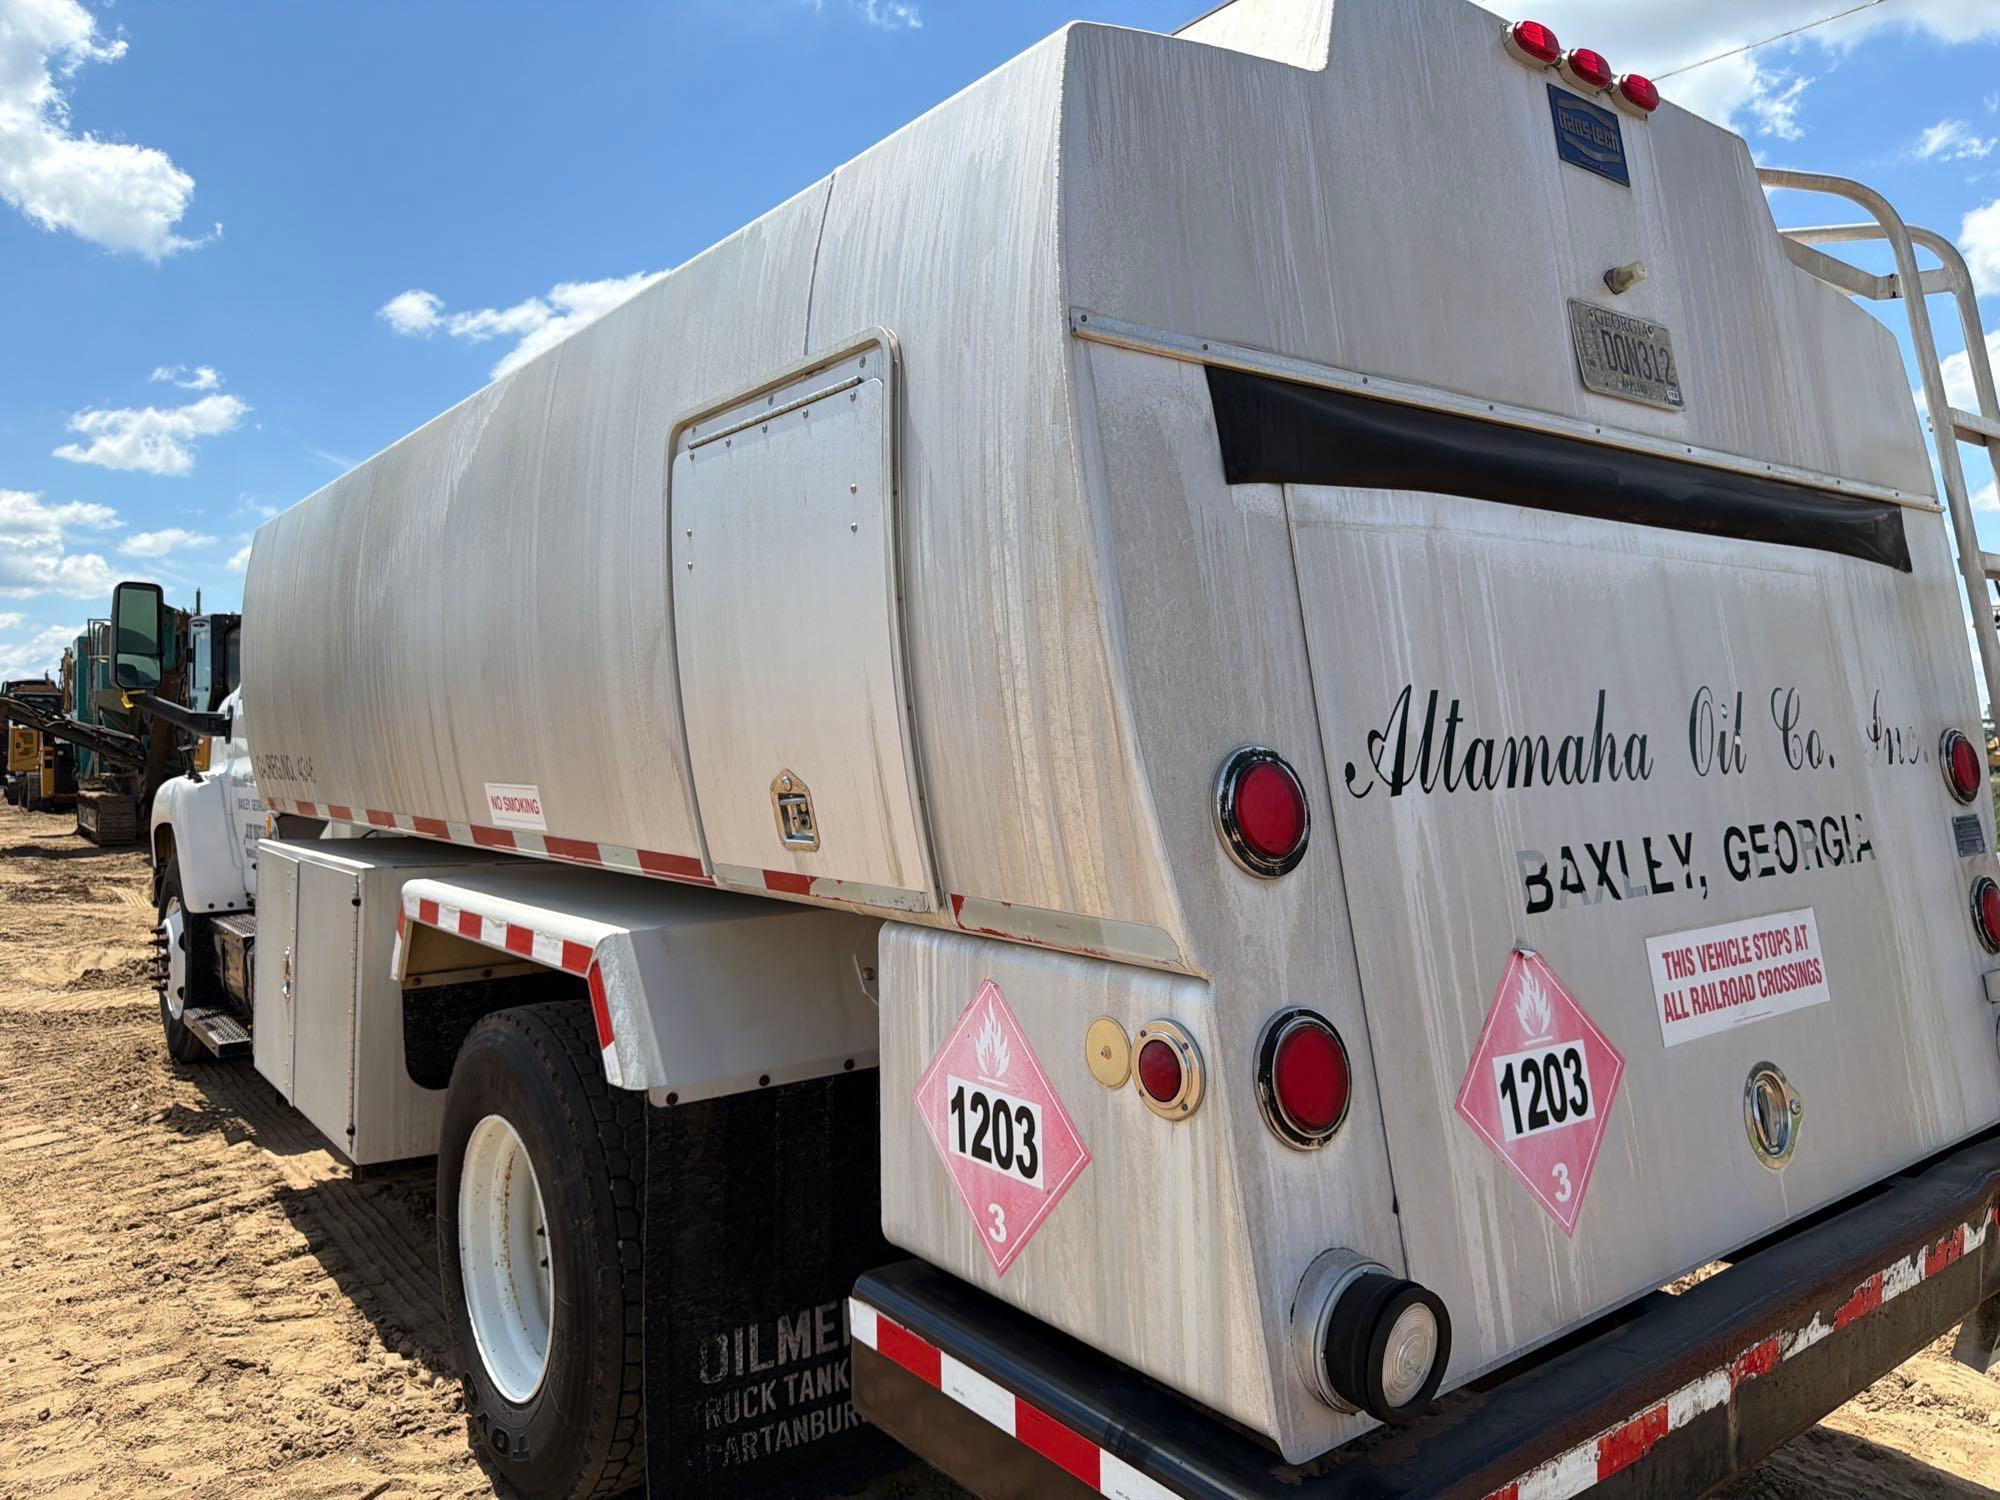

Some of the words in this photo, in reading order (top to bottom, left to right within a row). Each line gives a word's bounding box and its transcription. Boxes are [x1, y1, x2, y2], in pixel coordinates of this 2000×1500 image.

[1594, 308, 1650, 338] GEORGIA
[1345, 684, 1653, 798] Altamaha
[1689, 685, 1747, 776] Oil
[1770, 687, 1835, 770] Co.
[491, 795, 503, 811] NO
[503, 796, 540, 815] SMOKING
[1516, 831, 1708, 915] BAXLEY,
[1724, 813, 1876, 882] GEORGIA
[1662, 947, 1696, 980] THIS
[1696, 936, 1753, 973] VEHICLE
[1753, 927, 1792, 961] STOPS
[1793, 924, 1809, 952] AT
[1663, 990, 1690, 1023] ALL
[1689, 974, 1756, 1016] RAILROAD
[1757, 957, 1823, 999] CROSSINGS
[1500, 1047, 1589, 1135] 1203
[951, 1086, 1038, 1179] 1203
[1552, 1162, 1572, 1203] 3
[987, 1203, 1007, 1243] 3
